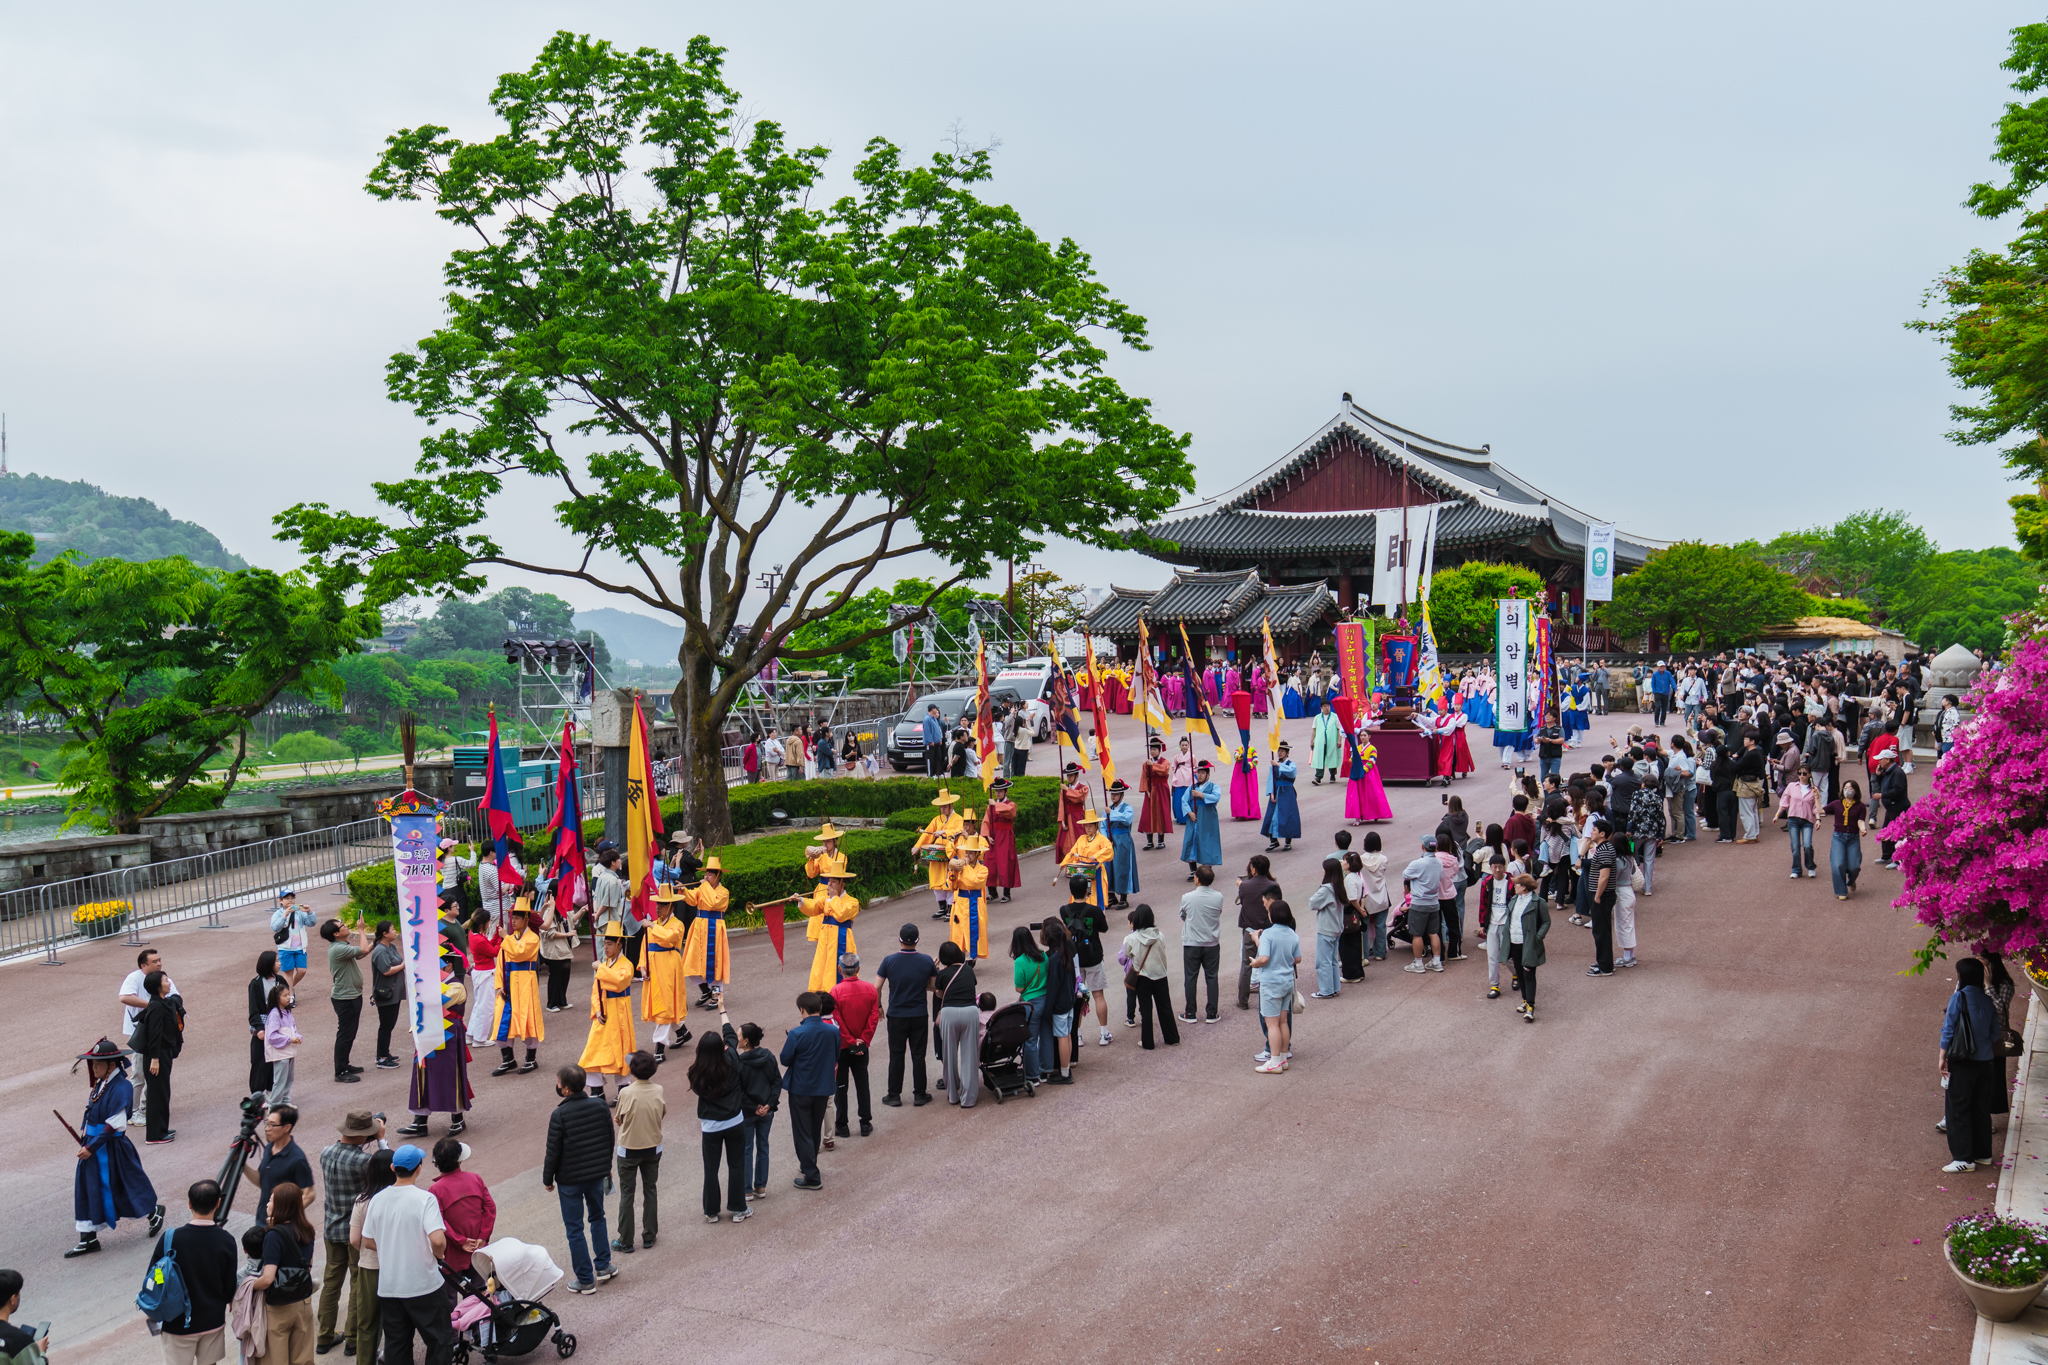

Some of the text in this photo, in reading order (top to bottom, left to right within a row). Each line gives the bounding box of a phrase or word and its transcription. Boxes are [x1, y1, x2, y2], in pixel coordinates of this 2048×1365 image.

[1505, 612, 1520, 719] 의암별제
[414, 849, 430, 860] 진주
[400, 864, 433, 876] 개제
